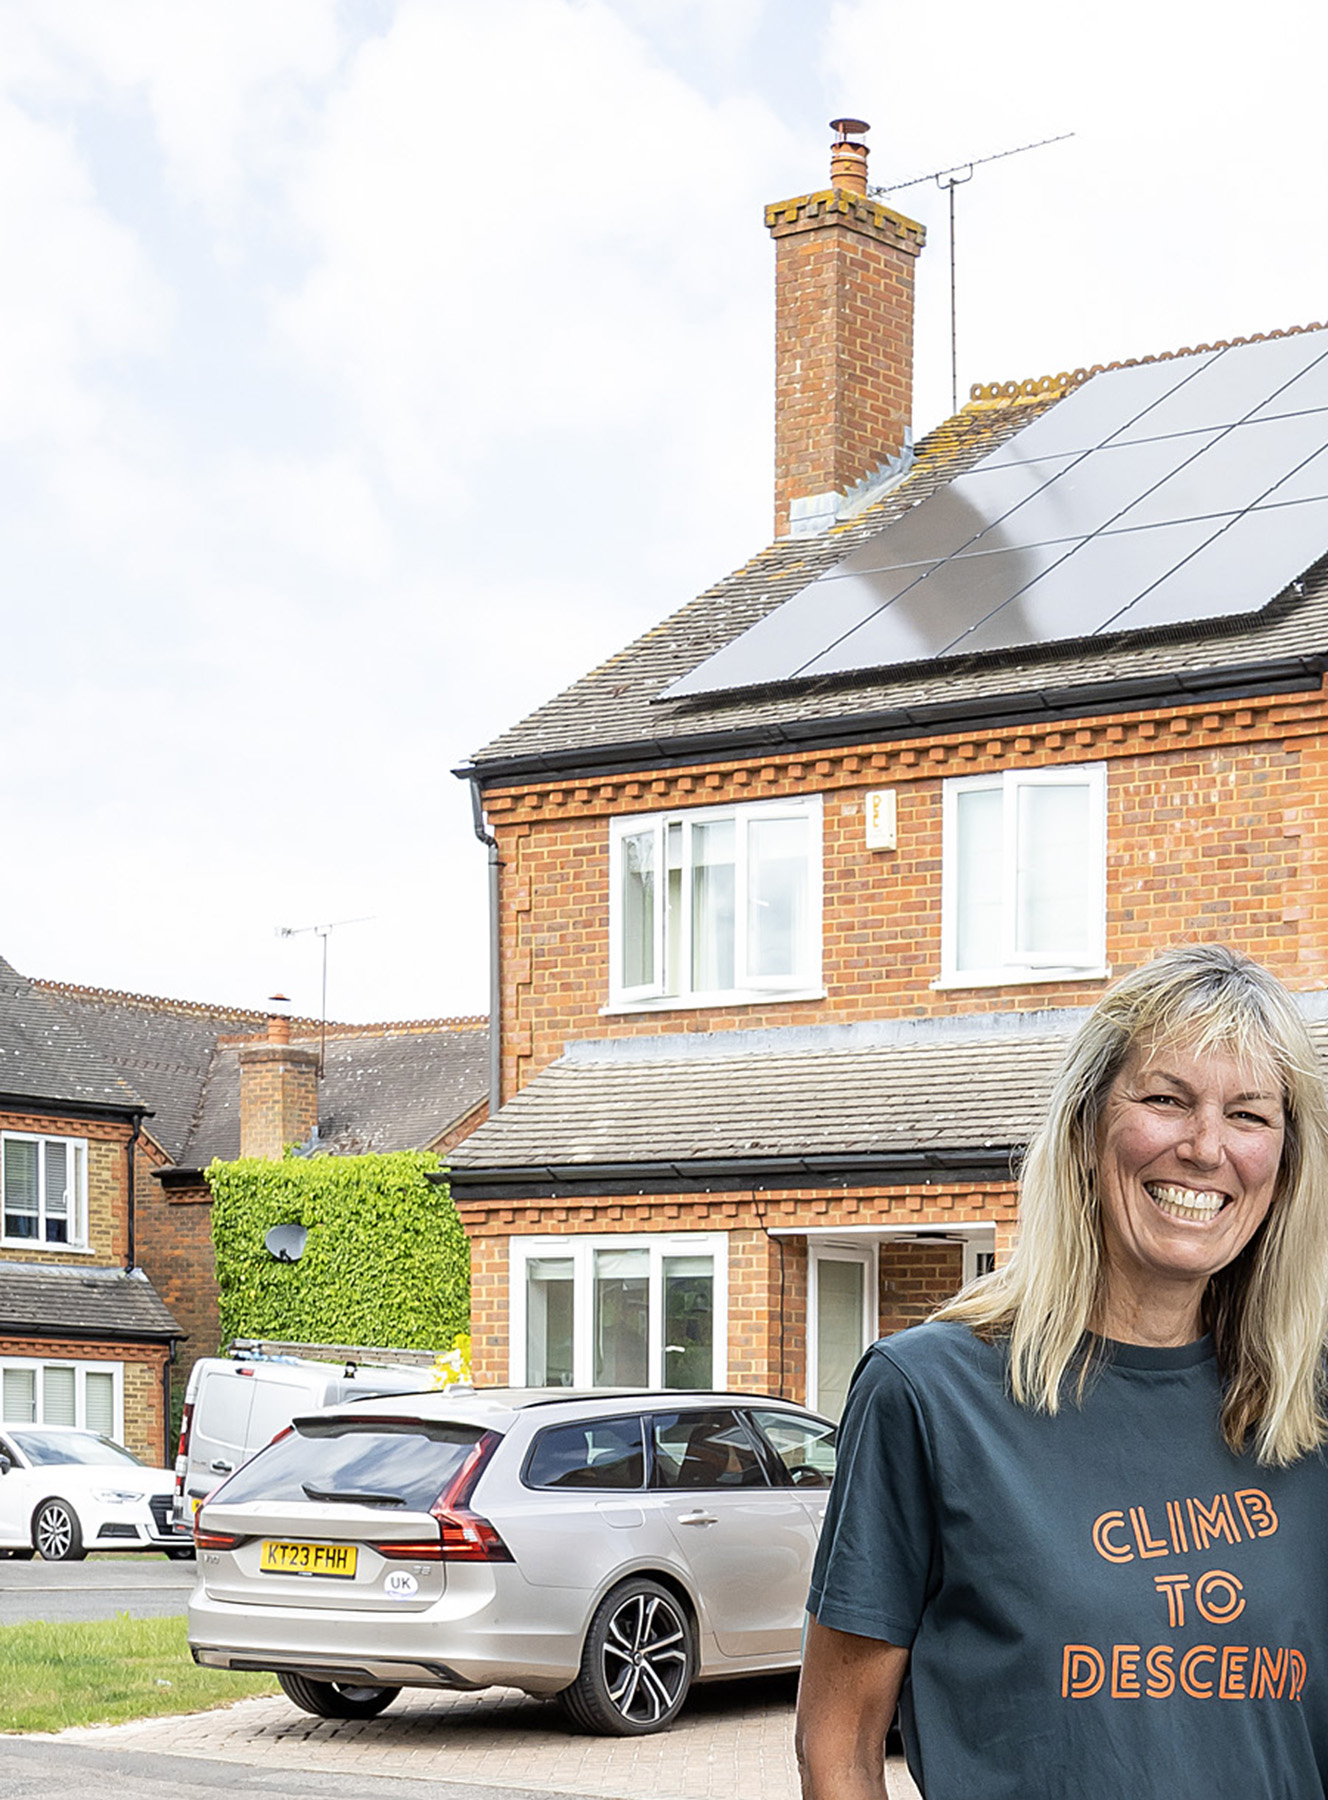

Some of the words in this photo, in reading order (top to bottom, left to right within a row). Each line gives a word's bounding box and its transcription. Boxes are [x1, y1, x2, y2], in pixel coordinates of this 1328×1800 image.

[1092, 1488, 1279, 1563] CLIMB
[268, 1544, 310, 1566] KT23
[314, 1547, 348, 1568] FHH
[391, 1576, 411, 1589] UK
[1154, 1569, 1246, 1627] TO
[1062, 1644, 1307, 1701] DESCEND
